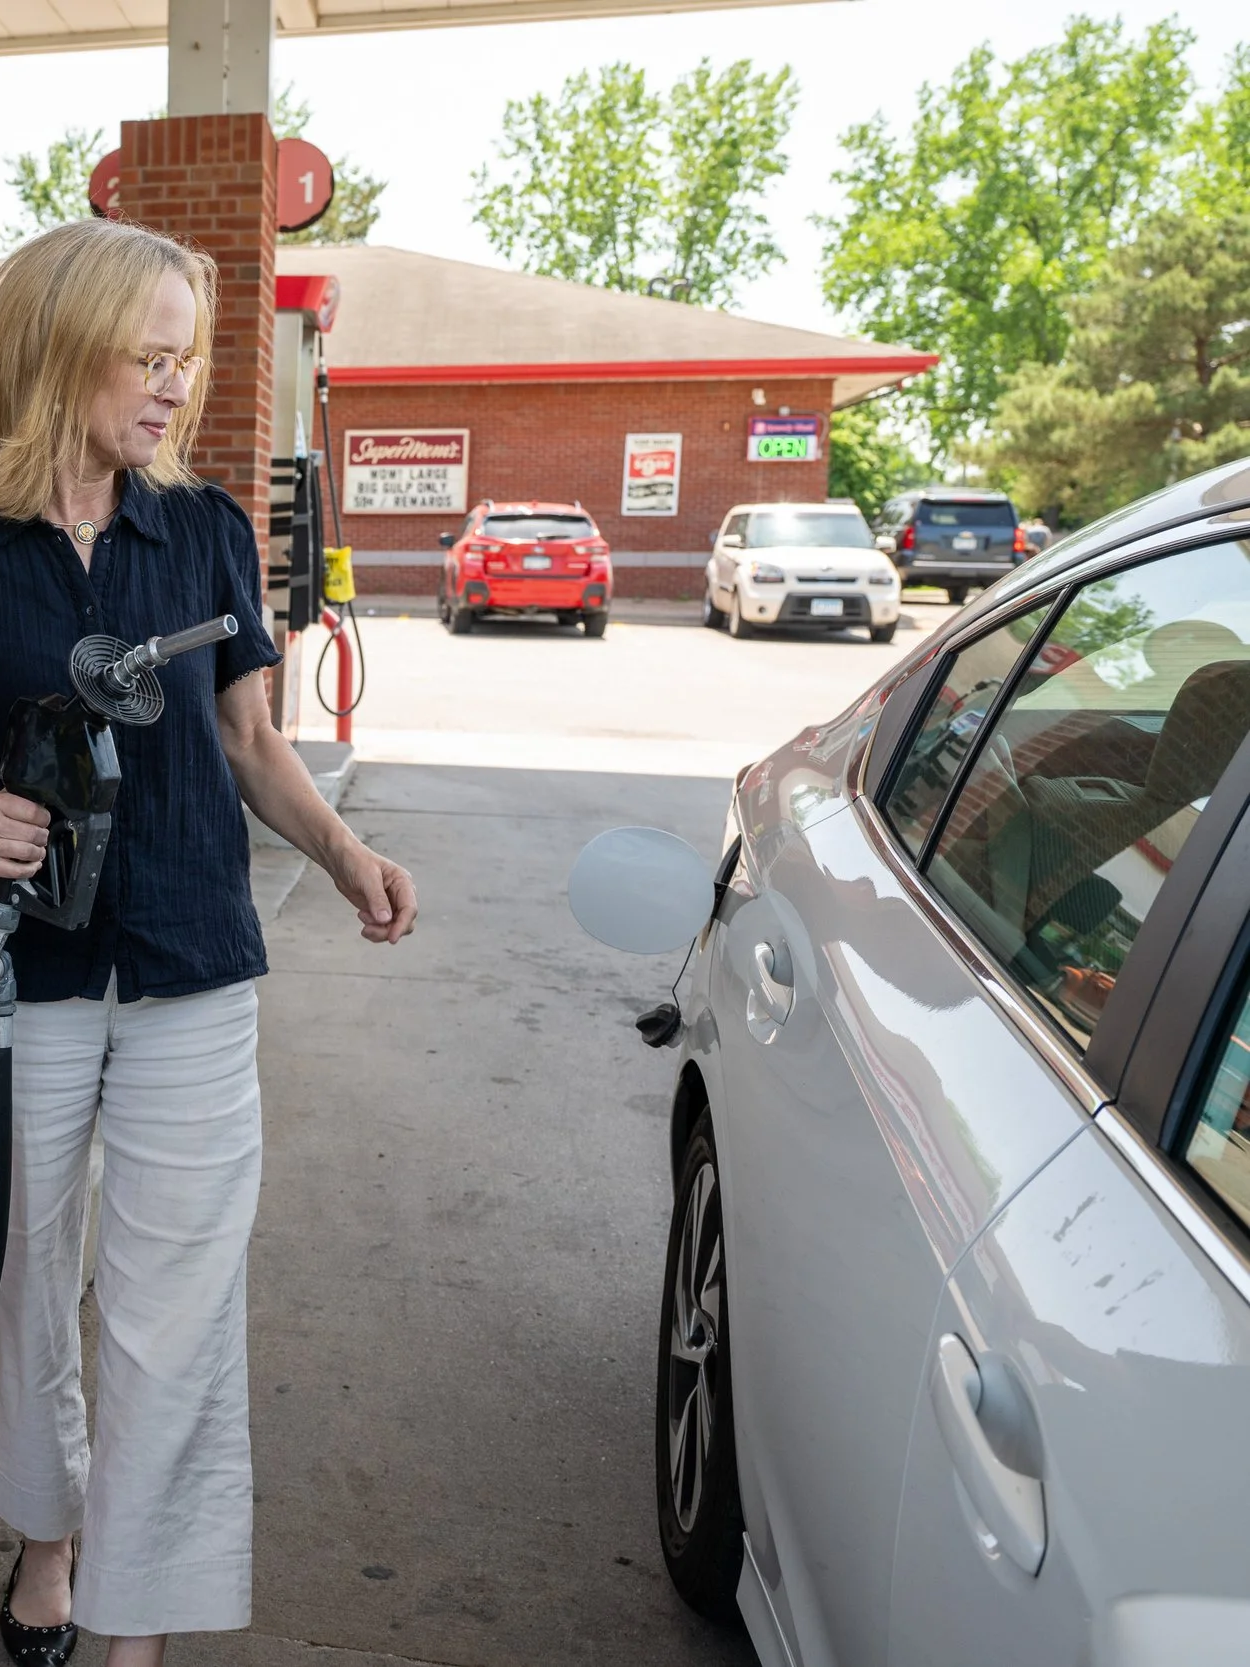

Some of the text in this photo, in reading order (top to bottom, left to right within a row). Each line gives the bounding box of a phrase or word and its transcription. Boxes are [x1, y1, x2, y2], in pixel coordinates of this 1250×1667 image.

[298, 171, 314, 204] 1
[758, 436, 807, 459] OPEN
[409, 468, 448, 480] LARGE
[357, 482, 447, 493] BIG GULP ONLY
[393, 496, 452, 508] REWARDS
